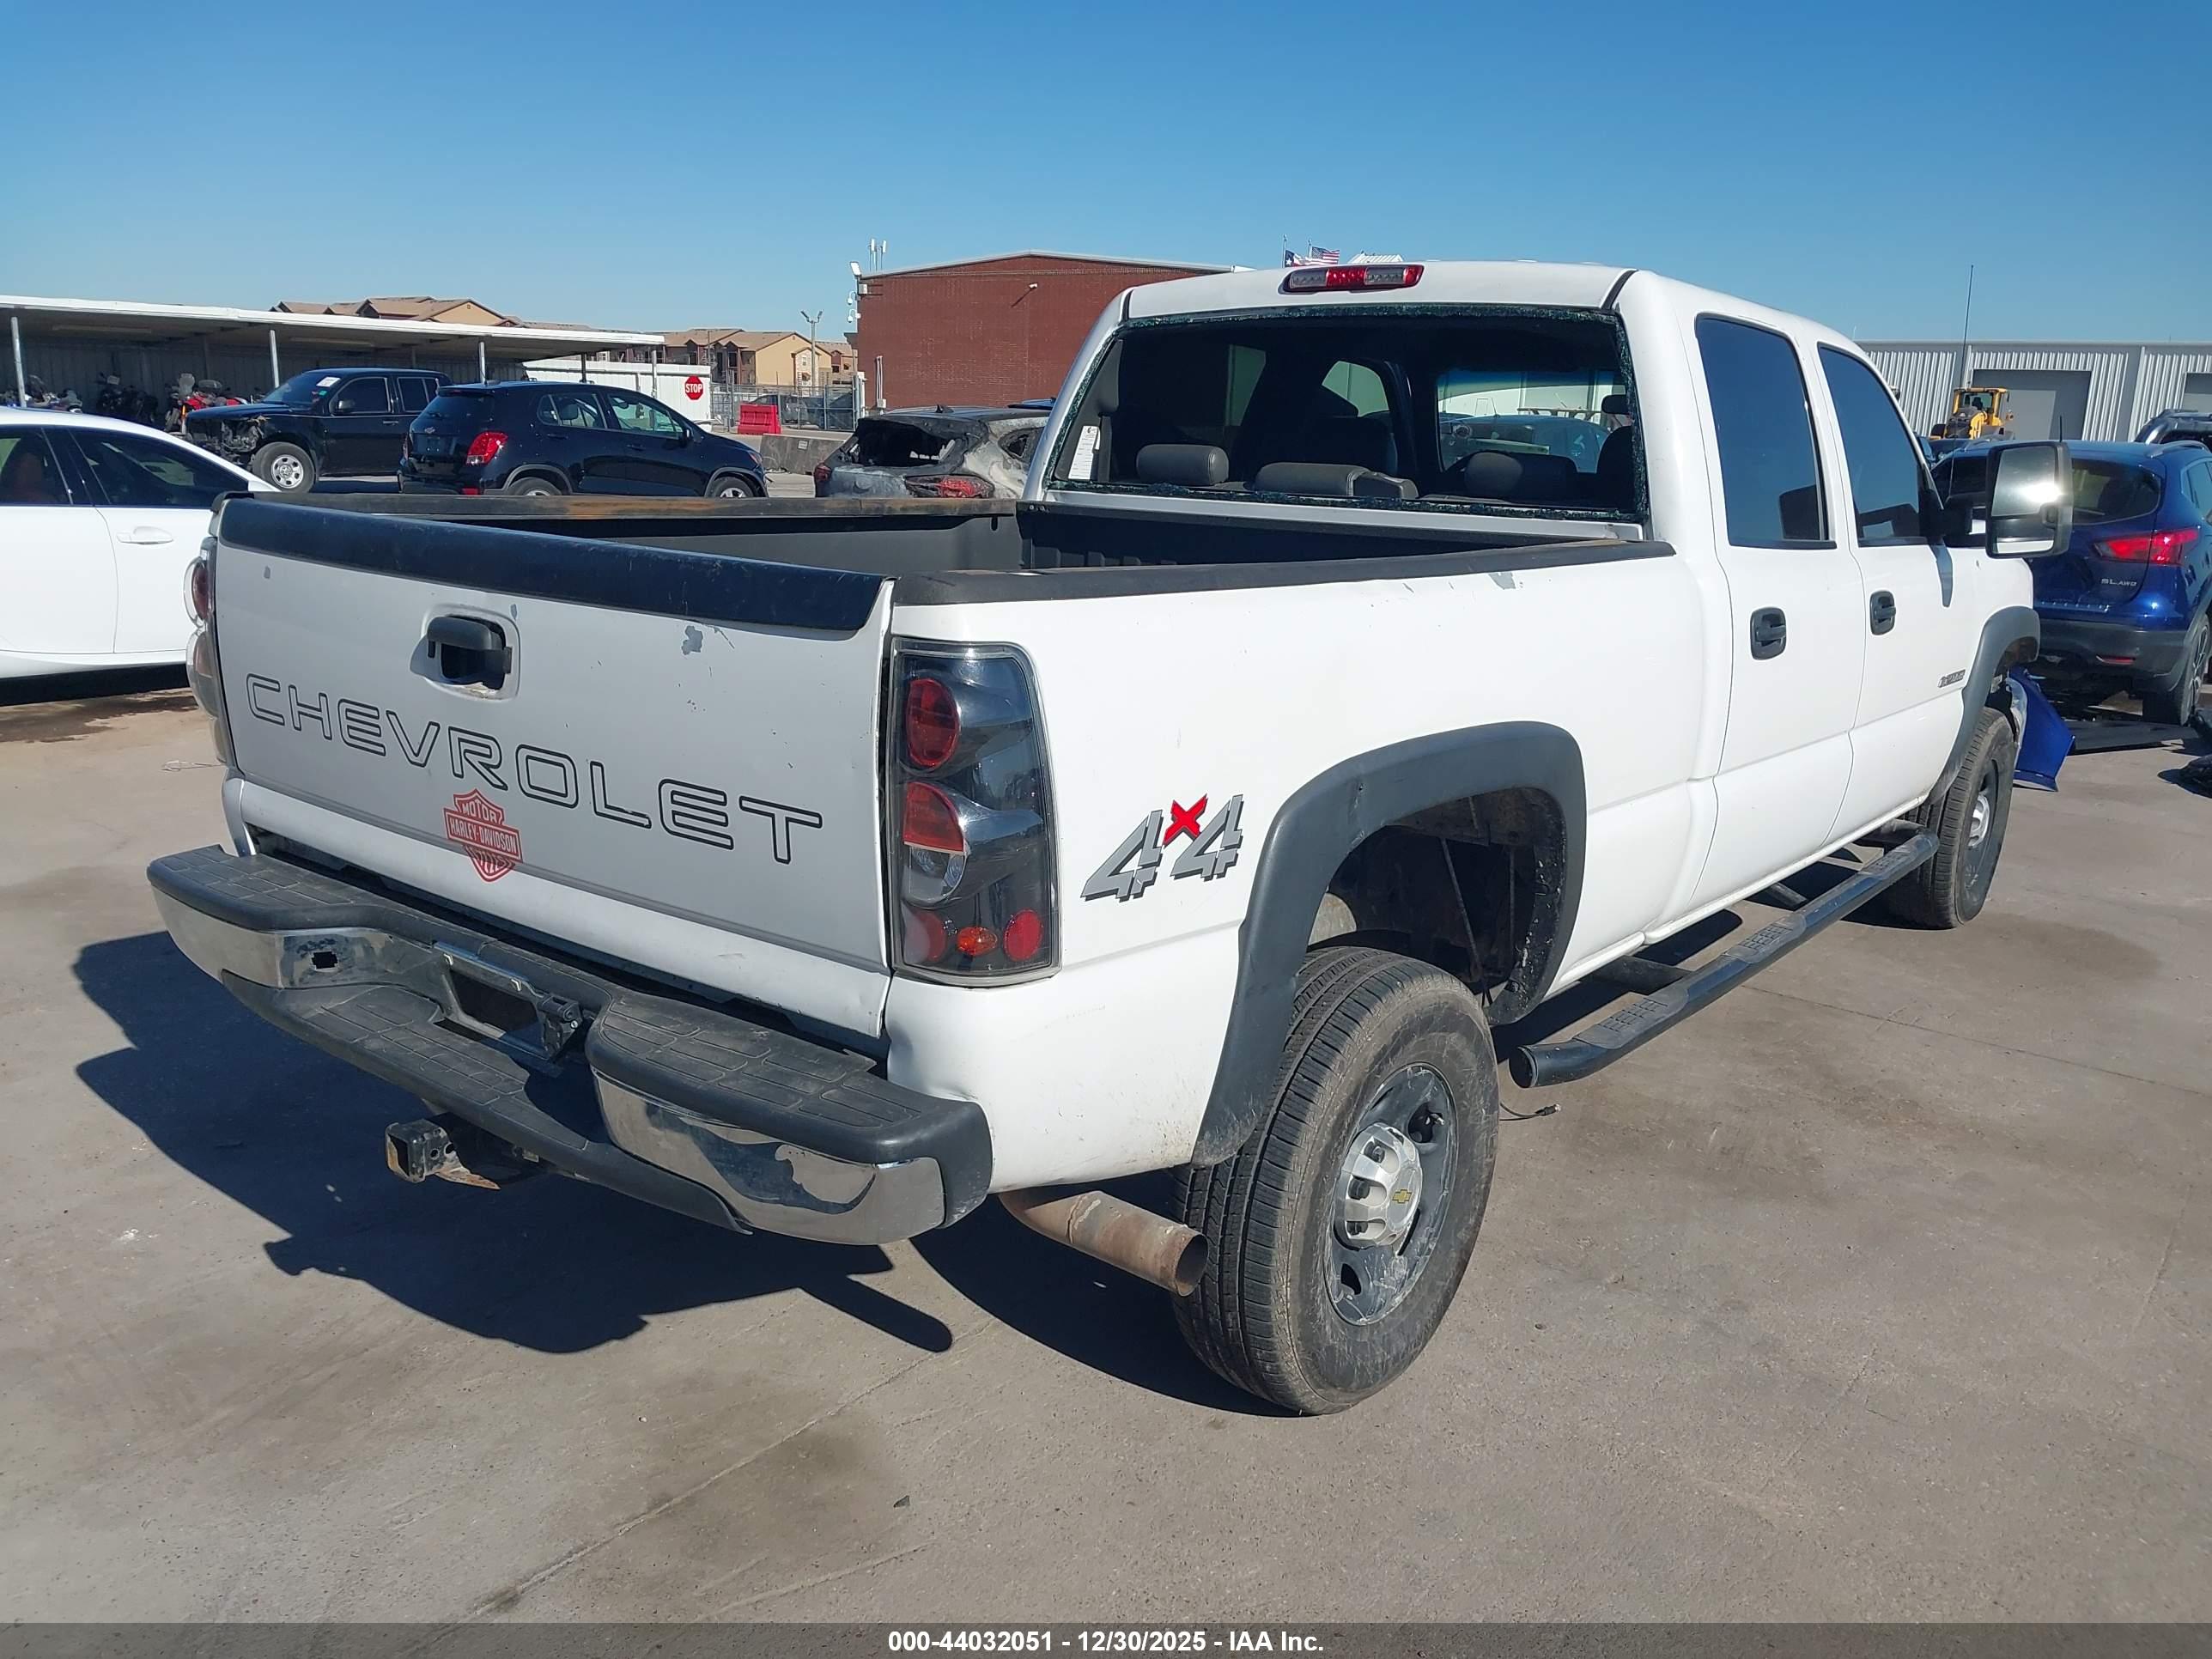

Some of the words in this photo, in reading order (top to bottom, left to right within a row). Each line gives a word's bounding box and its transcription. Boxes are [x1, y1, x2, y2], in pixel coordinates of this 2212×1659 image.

[685, 383, 702, 393] STOP
[246, 673, 823, 865] CHEVROLET
[461, 799, 498, 823] MOTOR
[448, 817, 517, 854] HARLEY-DAVIDSON
